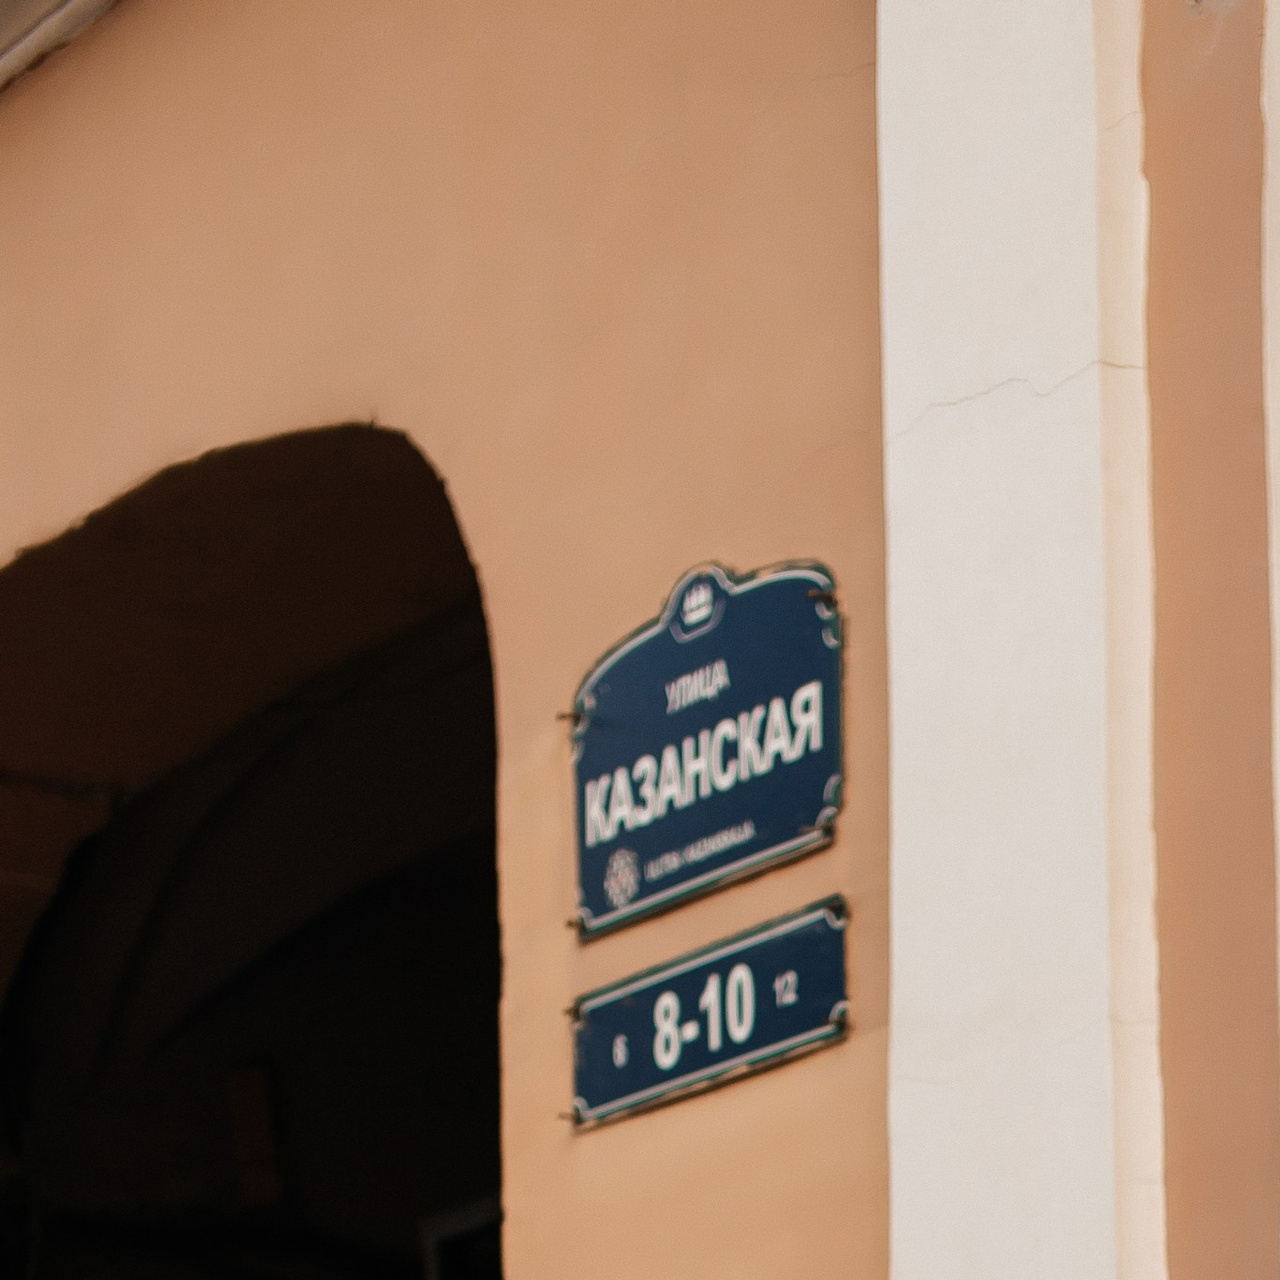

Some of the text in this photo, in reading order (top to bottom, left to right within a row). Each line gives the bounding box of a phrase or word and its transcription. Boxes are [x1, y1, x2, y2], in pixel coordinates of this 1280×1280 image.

[664, 658, 731, 715] УЛИЦА
[584, 679, 824, 848] КАЗАНСКАЯ
[653, 962, 756, 1071] 8-10
